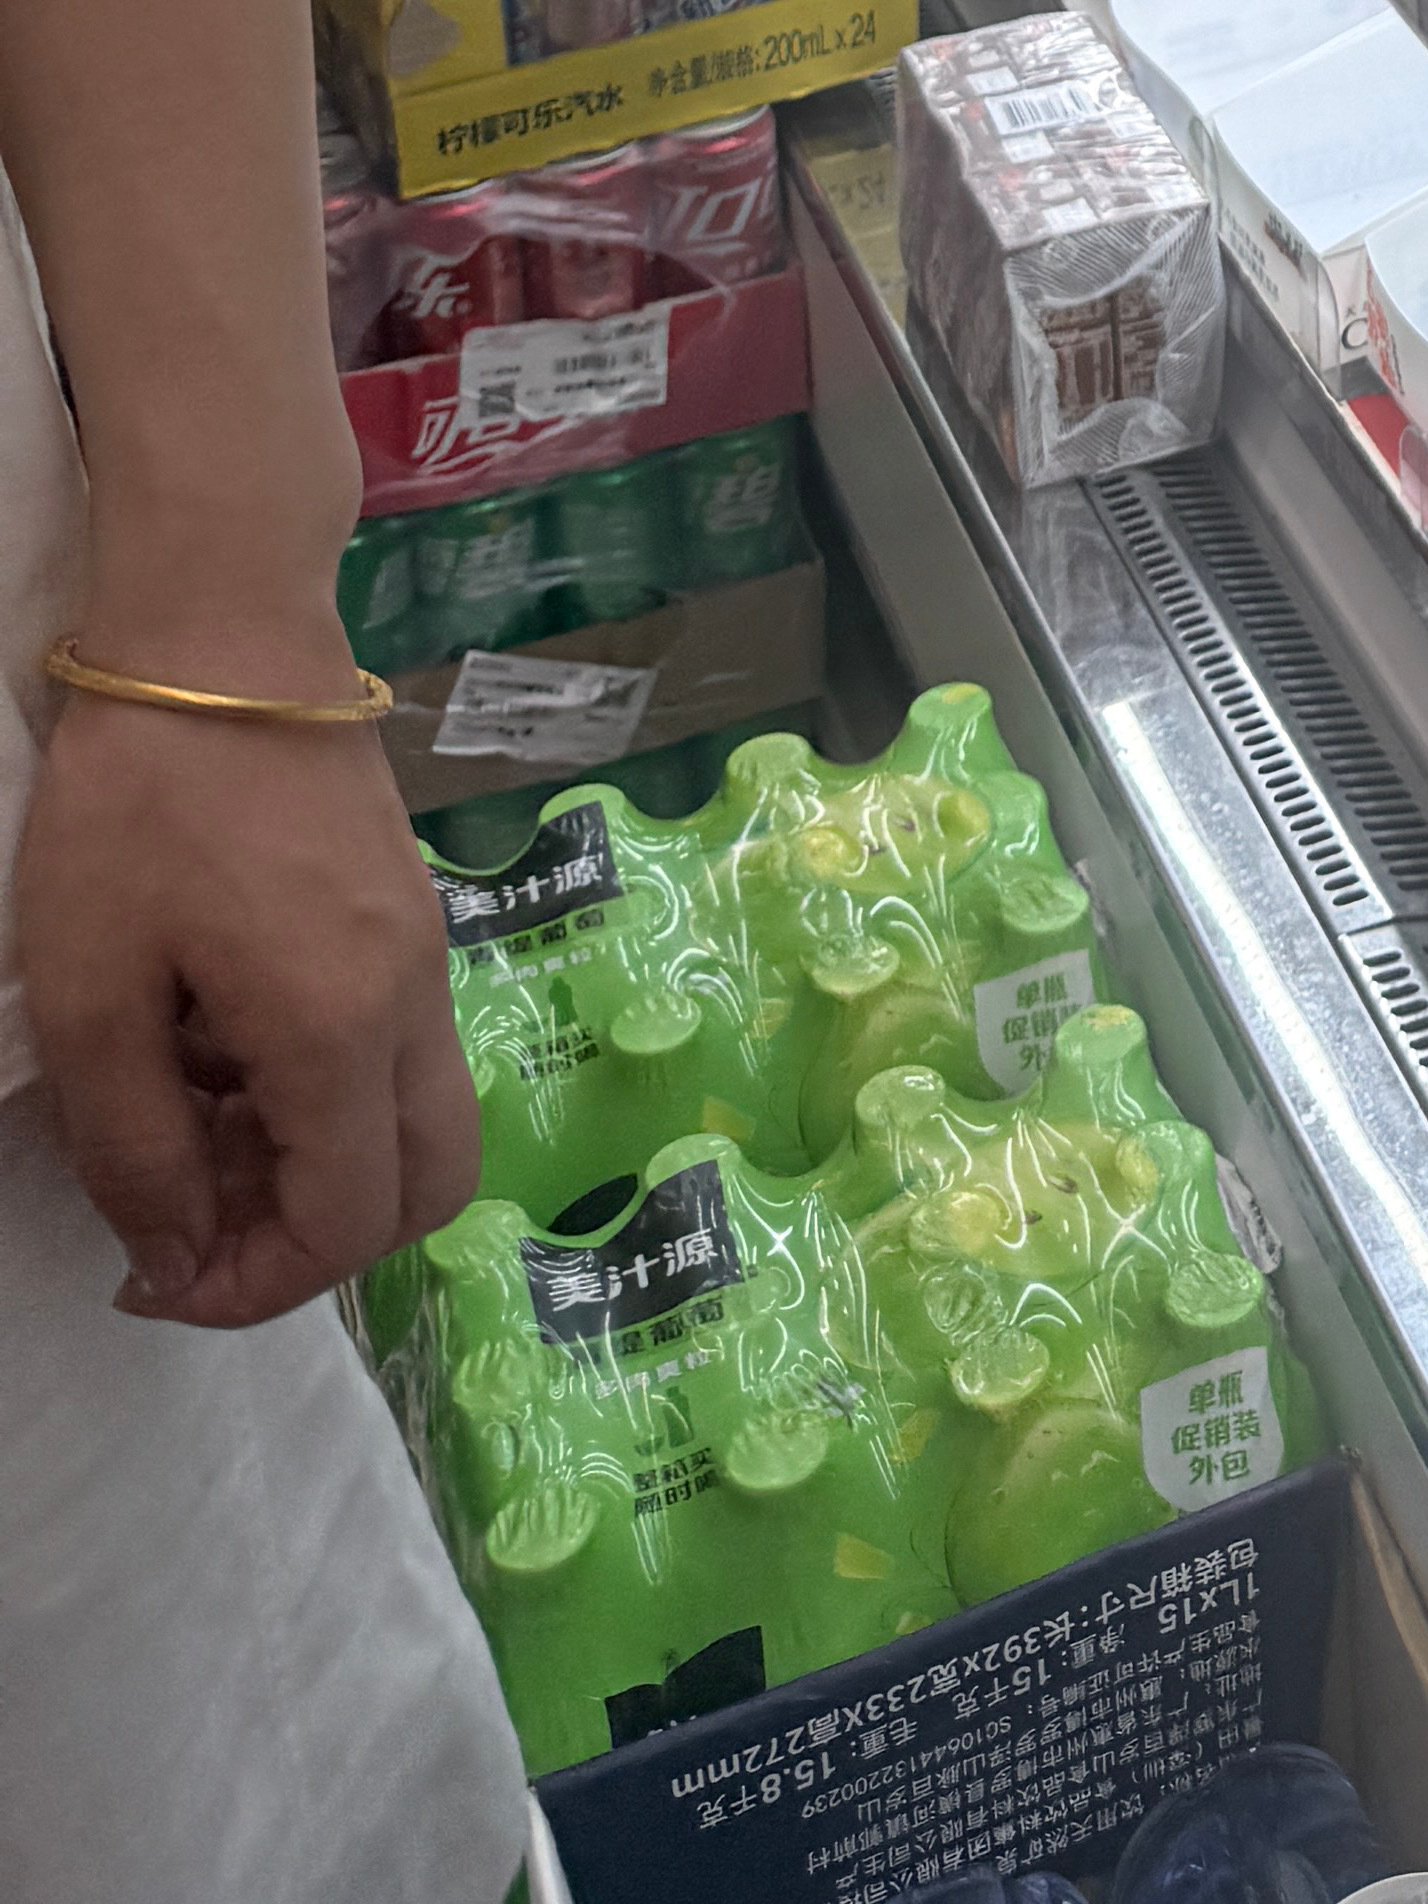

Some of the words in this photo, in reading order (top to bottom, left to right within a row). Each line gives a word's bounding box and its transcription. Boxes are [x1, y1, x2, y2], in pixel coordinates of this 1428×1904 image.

[449, 854, 602, 924] 美汁源
[1013, 969, 1070, 1009] 单瓶
[547, 1228, 717, 1312] 美汁源
[1187, 1369, 1244, 1412] 单瓶
[1170, 1406, 1262, 1451] 促销装
[1188, 1447, 1252, 1486] 外包
